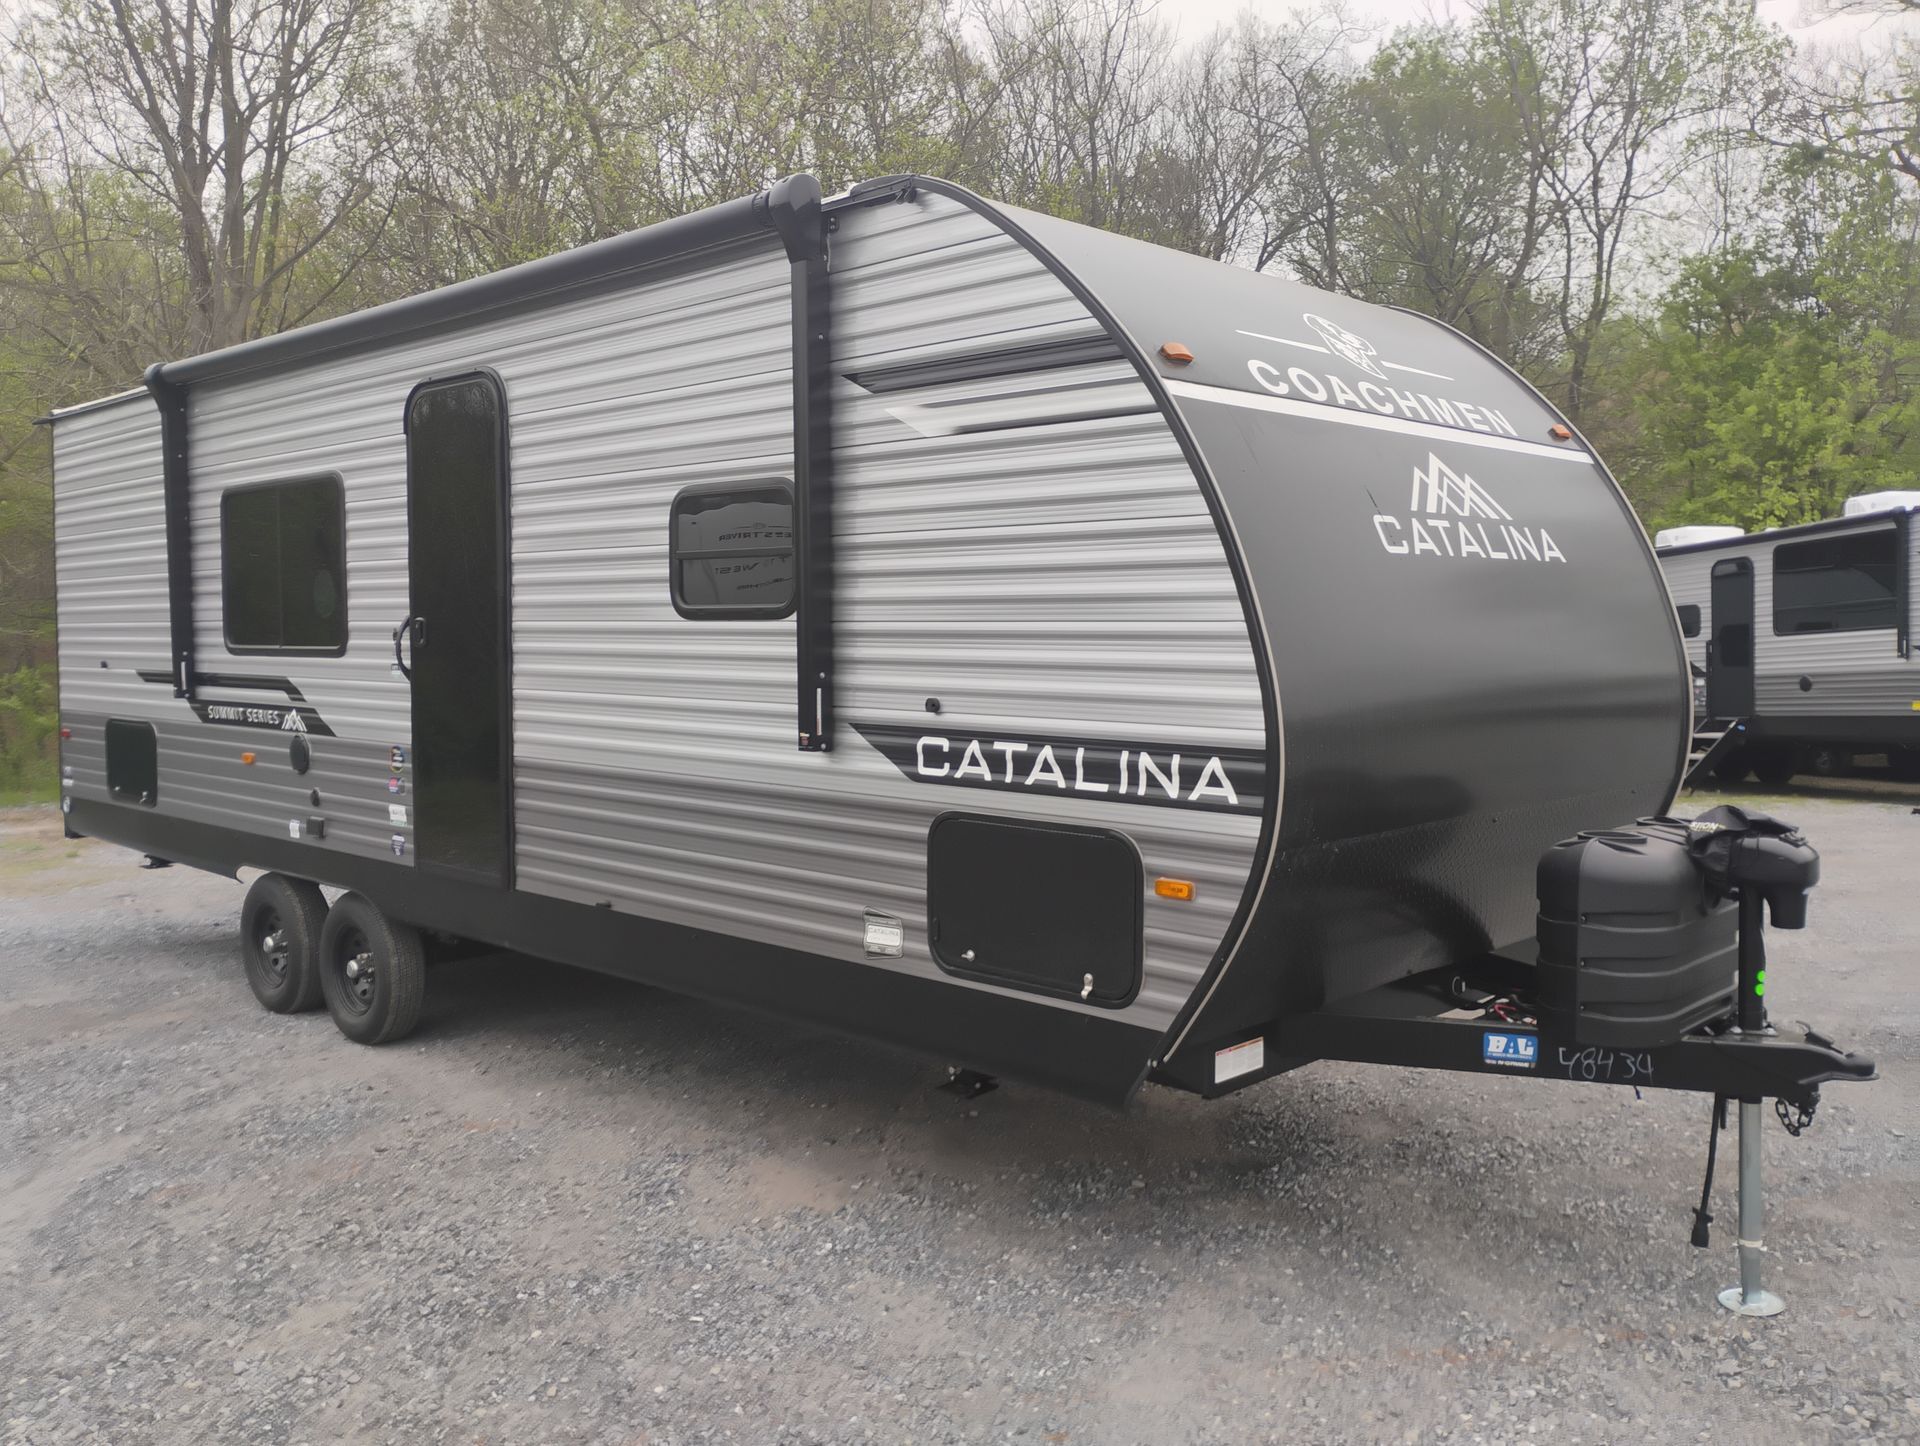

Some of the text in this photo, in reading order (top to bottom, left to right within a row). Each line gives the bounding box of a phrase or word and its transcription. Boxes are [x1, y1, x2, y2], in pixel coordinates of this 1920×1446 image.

[1247, 359, 1519, 437] COACHMEN
[1373, 514, 1567, 563] CATALINA
[208, 705, 280, 725] SUMMIT SERIES
[916, 736, 1238, 804] CATALINA
[1487, 1035, 1534, 1056] BAL
[1559, 1047, 1654, 1085] 48434
